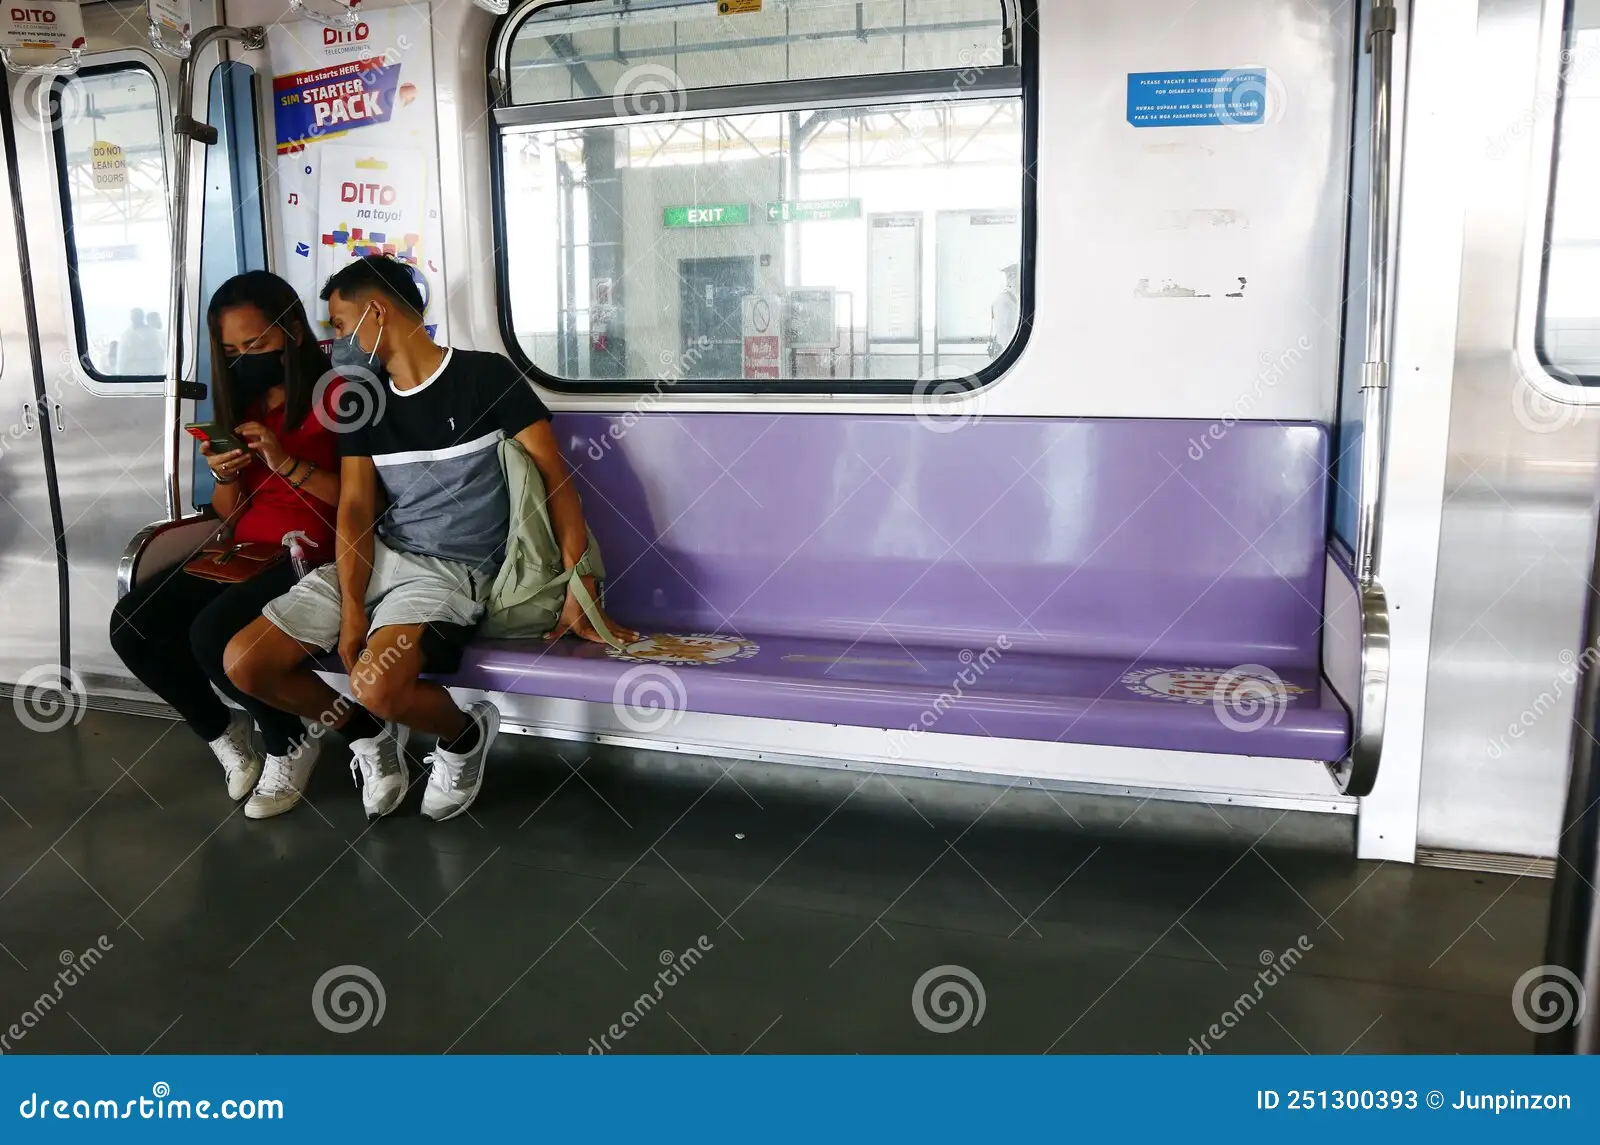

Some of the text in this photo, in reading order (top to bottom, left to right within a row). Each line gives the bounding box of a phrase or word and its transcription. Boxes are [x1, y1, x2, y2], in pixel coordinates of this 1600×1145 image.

[11, 8, 56, 22] DITO
[325, 45, 370, 55] TELECOMMUNITY
[296, 64, 360, 85] It all starts HERE
[281, 79, 363, 106] SIM STARTER
[314, 91, 383, 127] PACK
[93, 147, 105, 156] DO
[92, 160, 126, 170] LEAN ON
[96, 174, 124, 183] DOORS
[341, 182, 396, 205] DITO
[357, 208, 402, 223] na tayo!
[687, 208, 723, 223] EXIT
